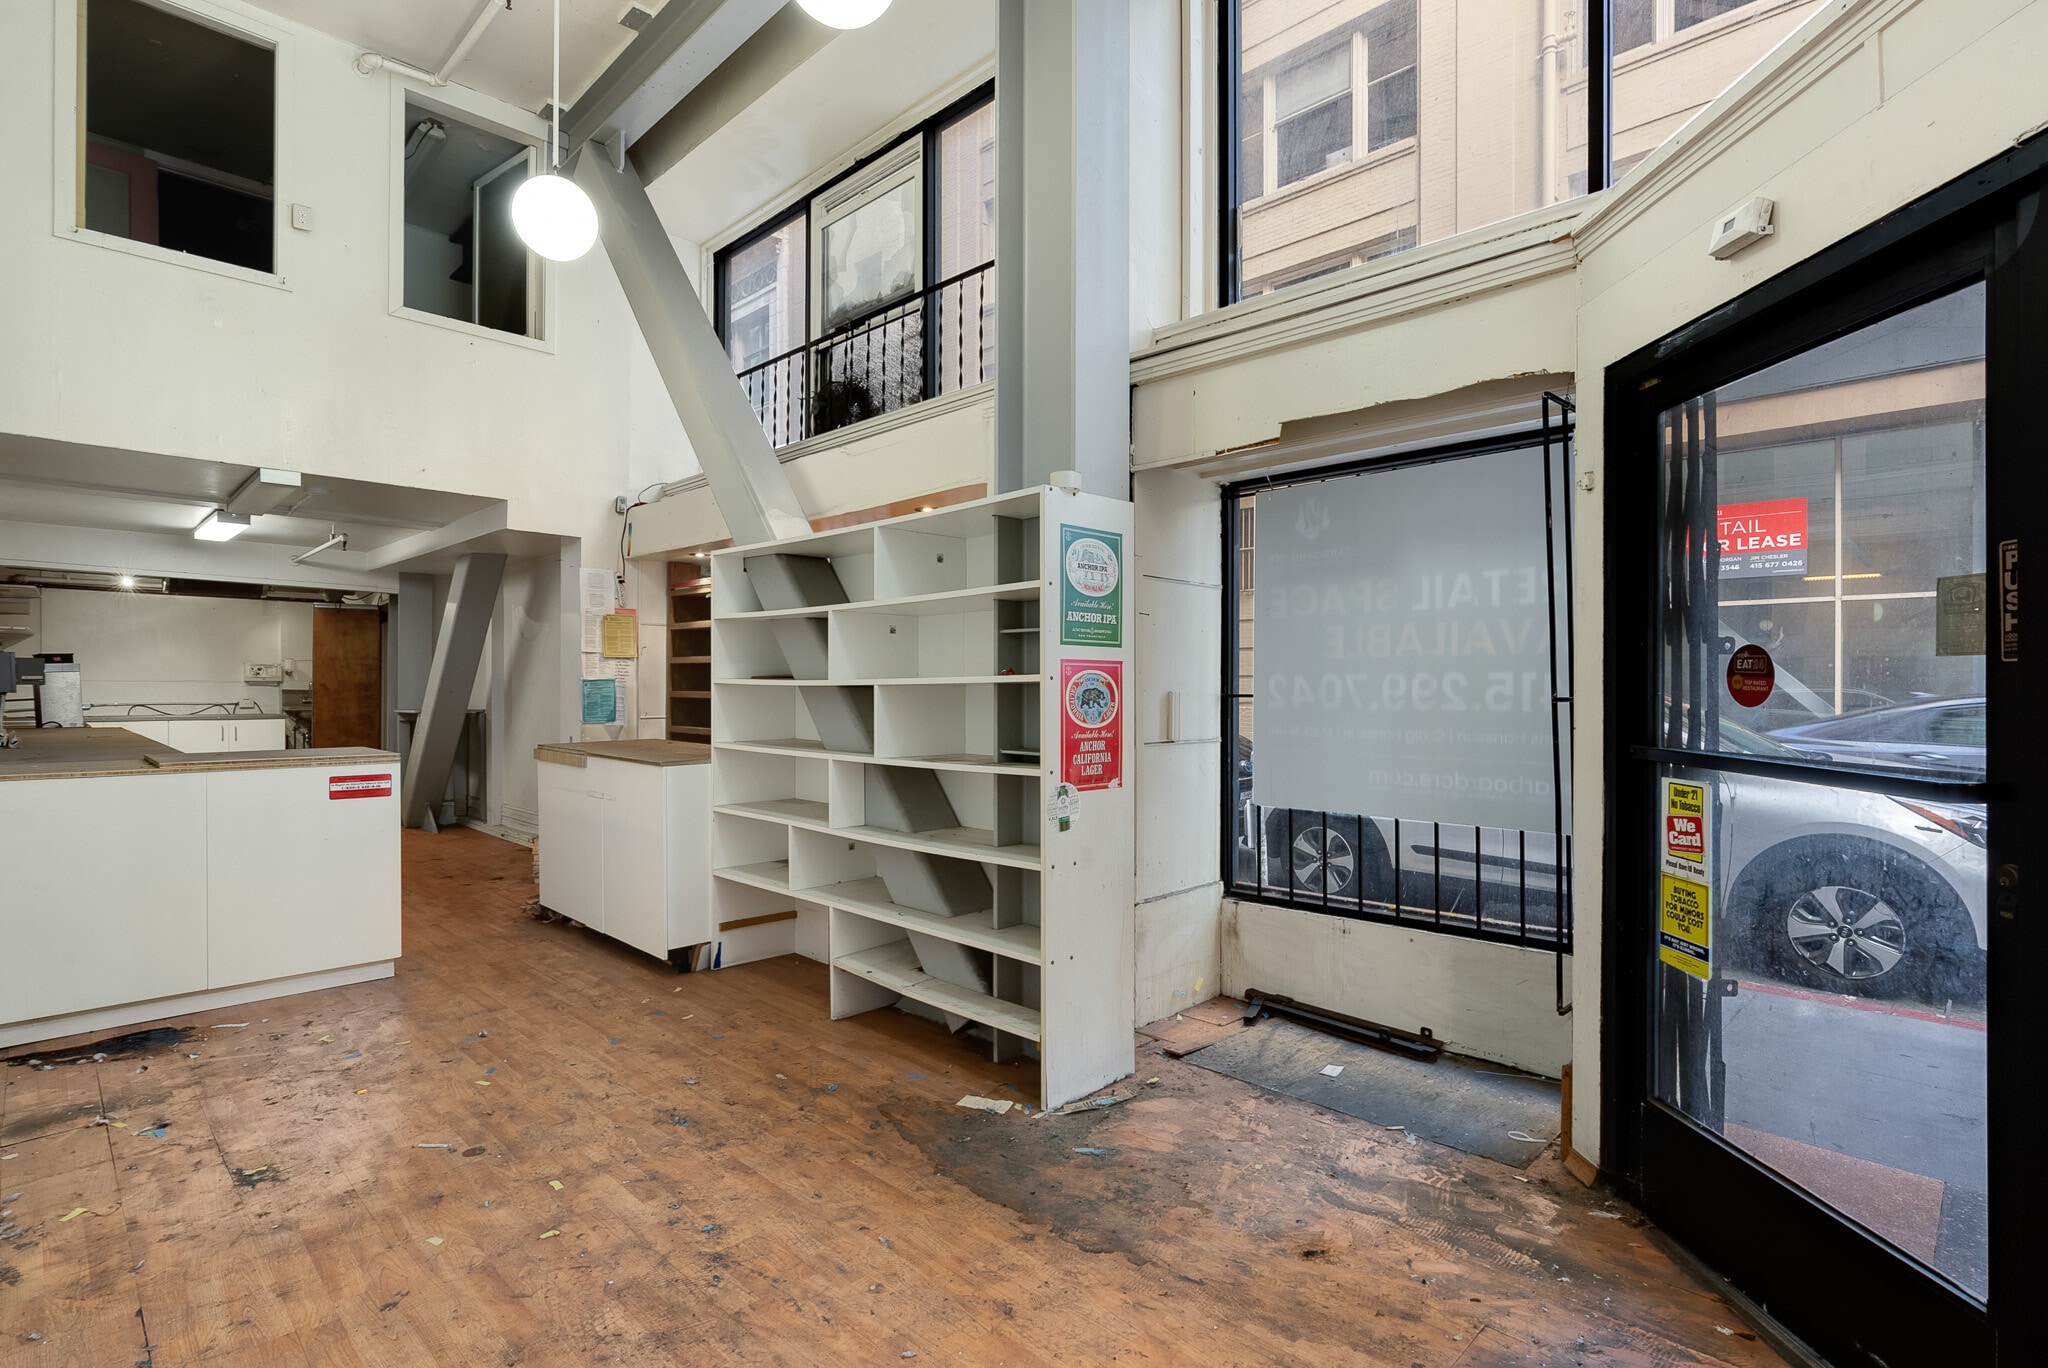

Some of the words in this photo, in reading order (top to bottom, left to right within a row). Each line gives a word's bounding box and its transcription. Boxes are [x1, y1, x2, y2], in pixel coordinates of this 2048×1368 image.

[1720, 519, 1767, 535] TAIL
[1737, 533, 1802, 550] LEASE
[1077, 563, 1098, 571] ANCHOR
[1071, 599, 1099, 609] Available
[1067, 611, 1102, 623] ANCHOR
[1103, 614, 1117, 625] IPA
[1071, 730, 1098, 739] Available
[1080, 740, 1106, 752] ANCHOR
[1072, 752, 1112, 765] CALIFORNIA
[1081, 764, 1103, 776] LAGER
[1673, 786, 1690, 799] Under
[1691, 789, 1698, 800] 21
[1671, 799, 1678, 809] No
[1679, 800, 1700, 813] Tobacco
[1673, 818, 1696, 832] We
[1669, 831, 1701, 846] Card
[1673, 886, 1696, 899] BUYING
[1670, 894, 1699, 909] TOBACCO
[1666, 901, 1677, 911] FOR
[1680, 906, 1704, 920] MINORS
[1666, 910, 1686, 922] COULD
[1688, 917, 1703, 929] COST
[1677, 922, 1692, 934] YOU.
